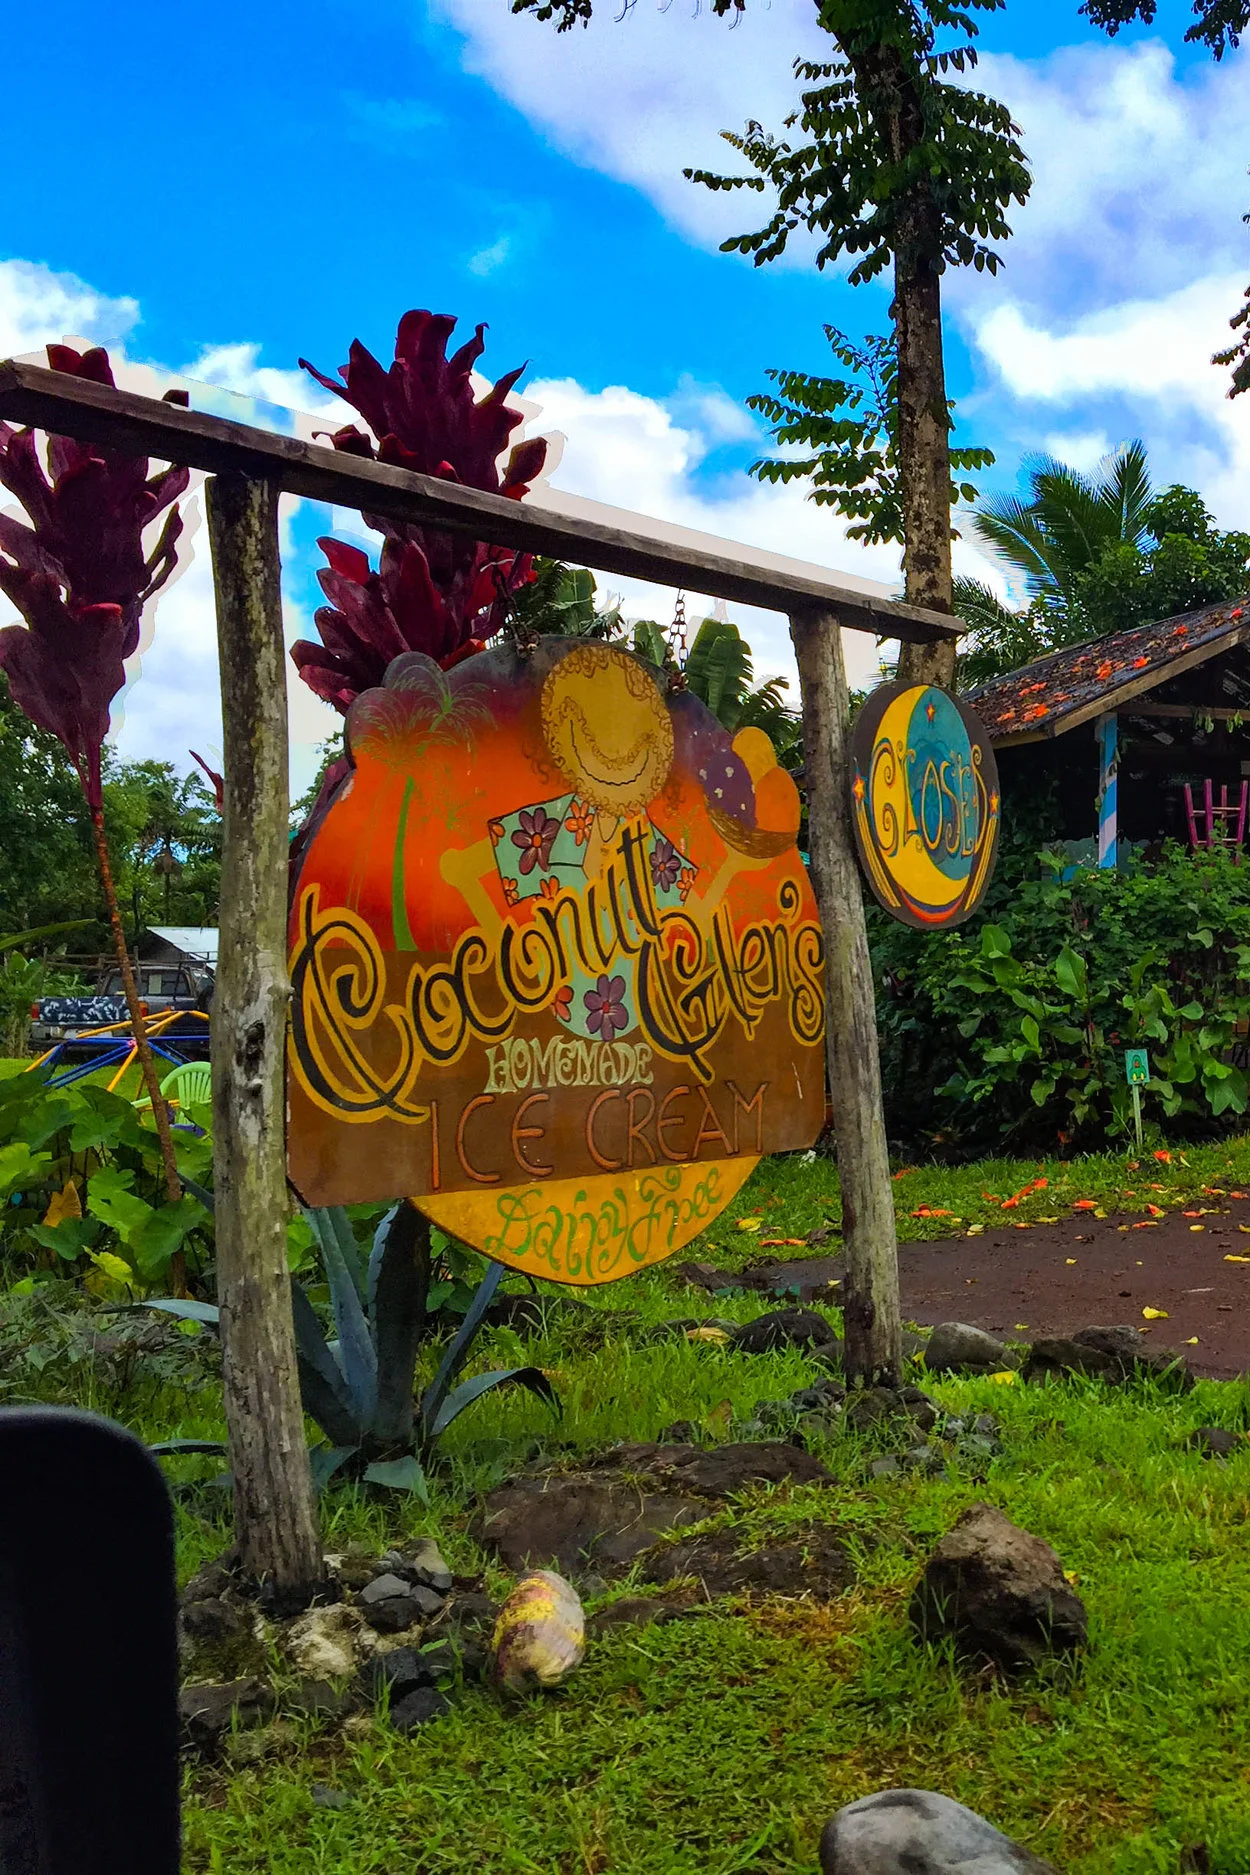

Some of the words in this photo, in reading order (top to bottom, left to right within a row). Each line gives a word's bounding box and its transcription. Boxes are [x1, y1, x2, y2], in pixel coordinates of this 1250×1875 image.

[291, 822, 664, 1121] Coconut
[637, 880, 826, 1082] Glen's
[484, 1035, 654, 1094] HOMEMADE
[430, 1092, 555, 1190] ICE
[585, 1080, 771, 1172] CREAM
[484, 1187, 629, 1280] Dairy
[627, 1166, 724, 1262] Free
